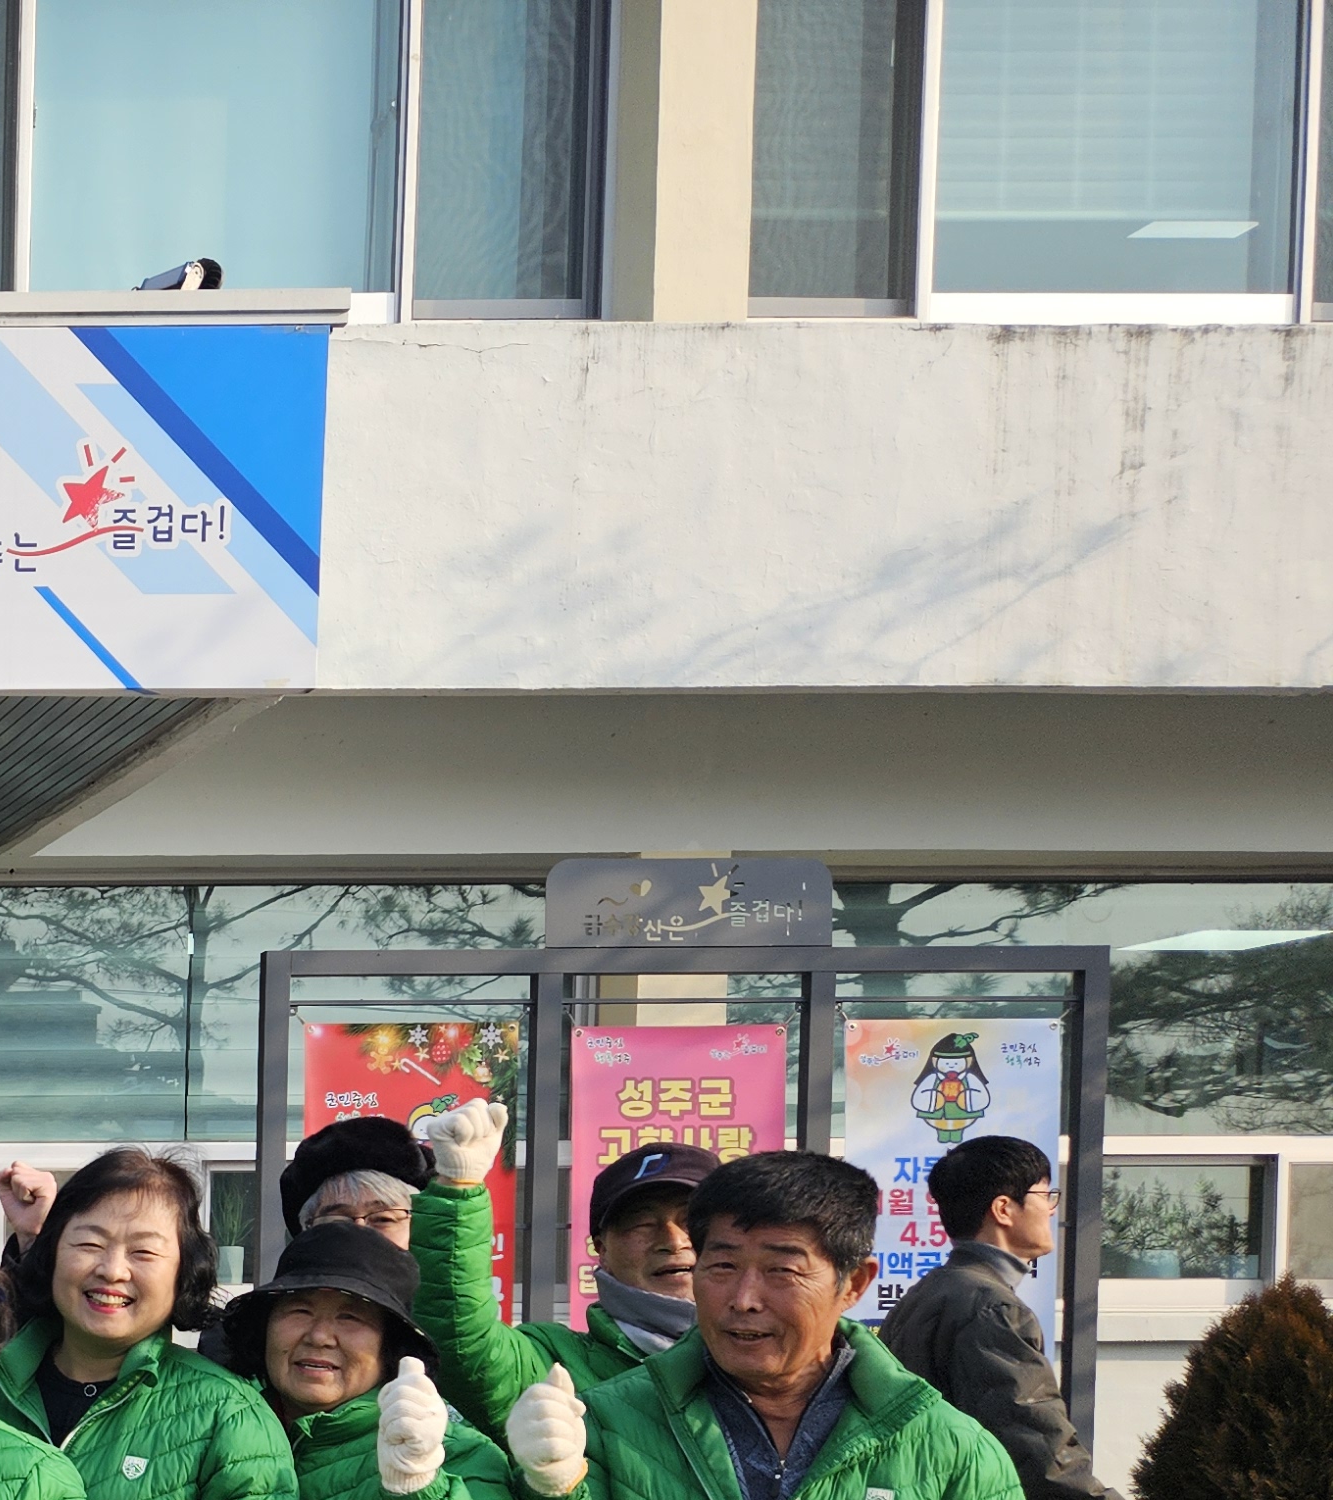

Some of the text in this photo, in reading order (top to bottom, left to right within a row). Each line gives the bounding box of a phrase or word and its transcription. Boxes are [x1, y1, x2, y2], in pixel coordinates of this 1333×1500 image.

[112, 504, 225, 550] 즐겁다!
[325, 1091, 379, 1108] 군민중심
[618, 1079, 733, 1118] 성주군
[899, 1221, 949, 1247] 4.5
